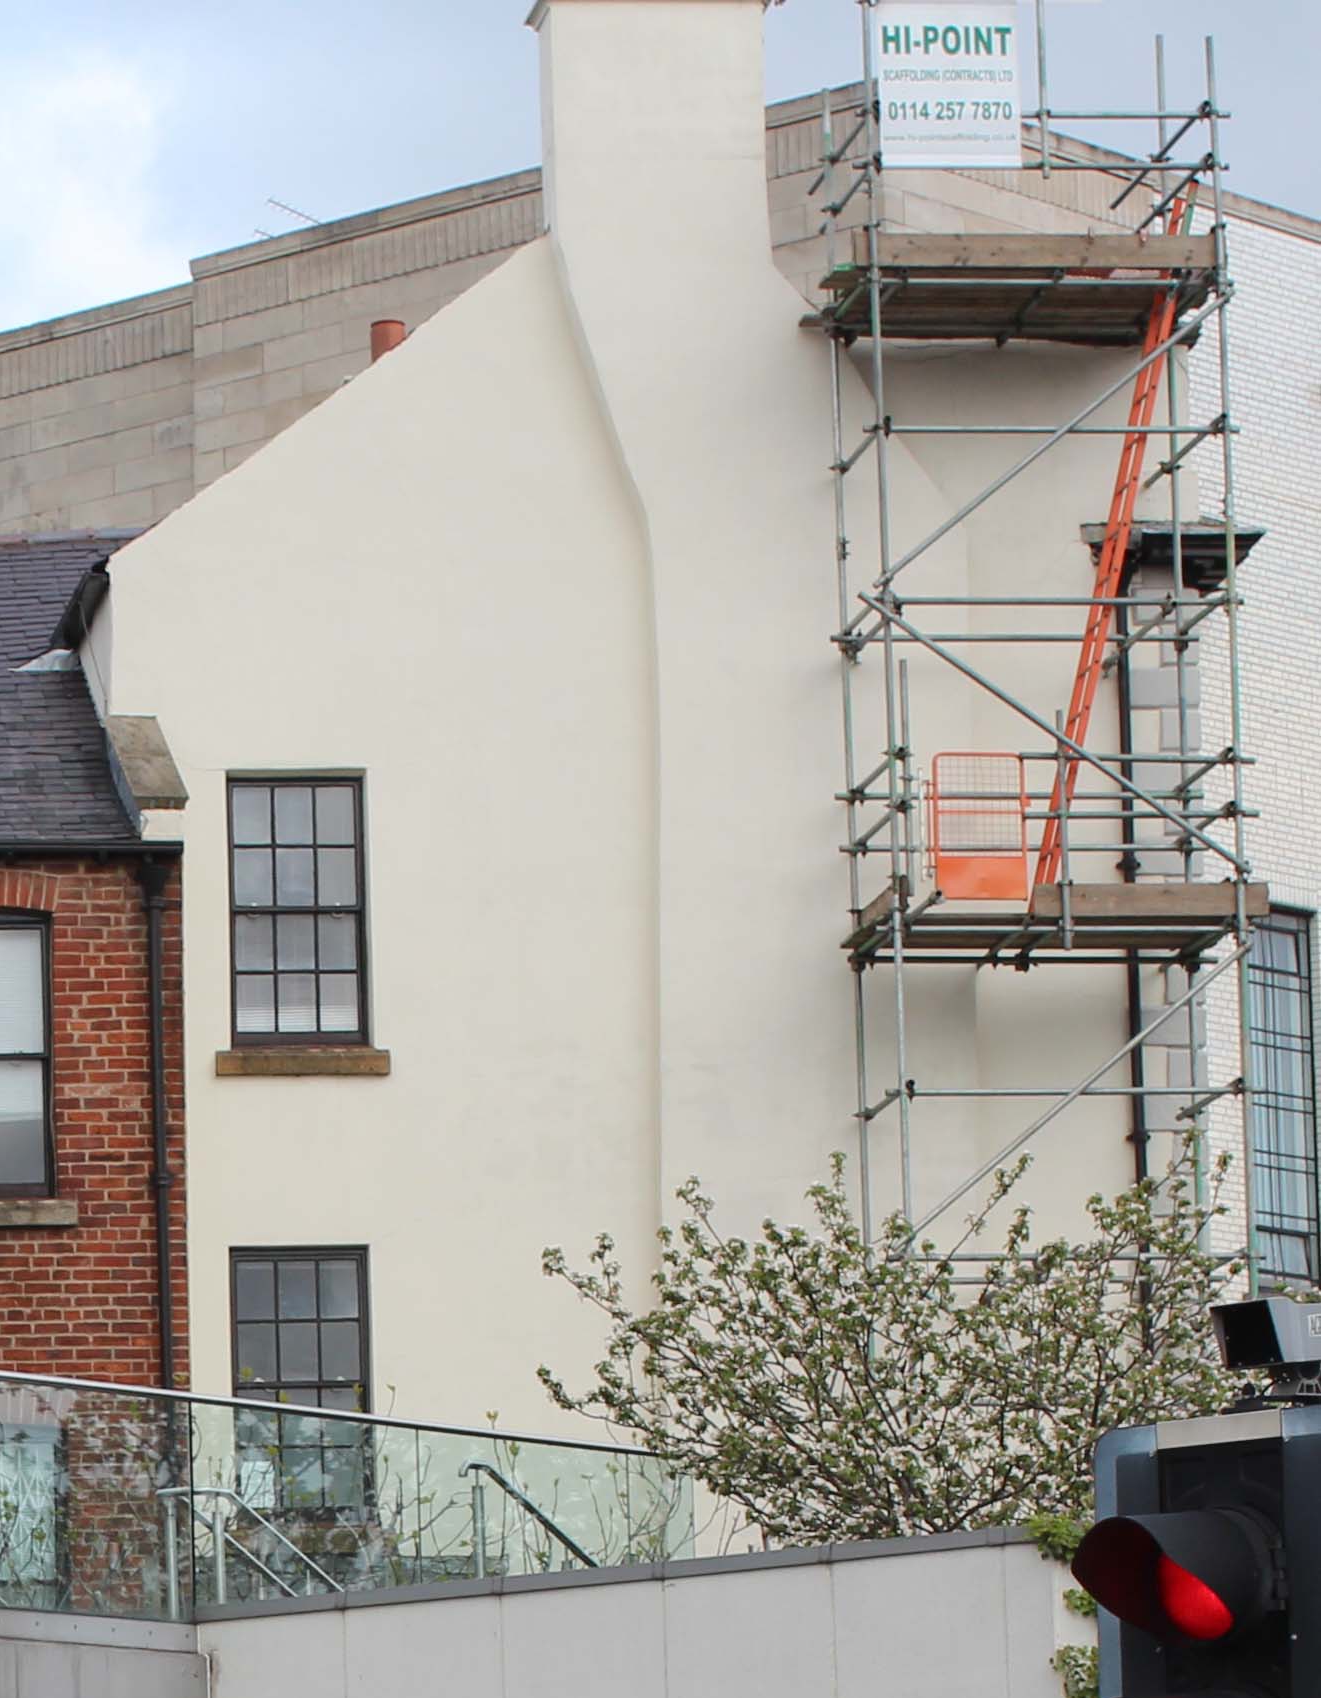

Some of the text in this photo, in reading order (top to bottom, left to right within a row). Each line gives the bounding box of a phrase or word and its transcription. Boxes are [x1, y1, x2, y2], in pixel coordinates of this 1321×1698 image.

[881, 25, 1012, 55] HI-POINT
[888, 100, 1013, 121] 0114 257 7870
